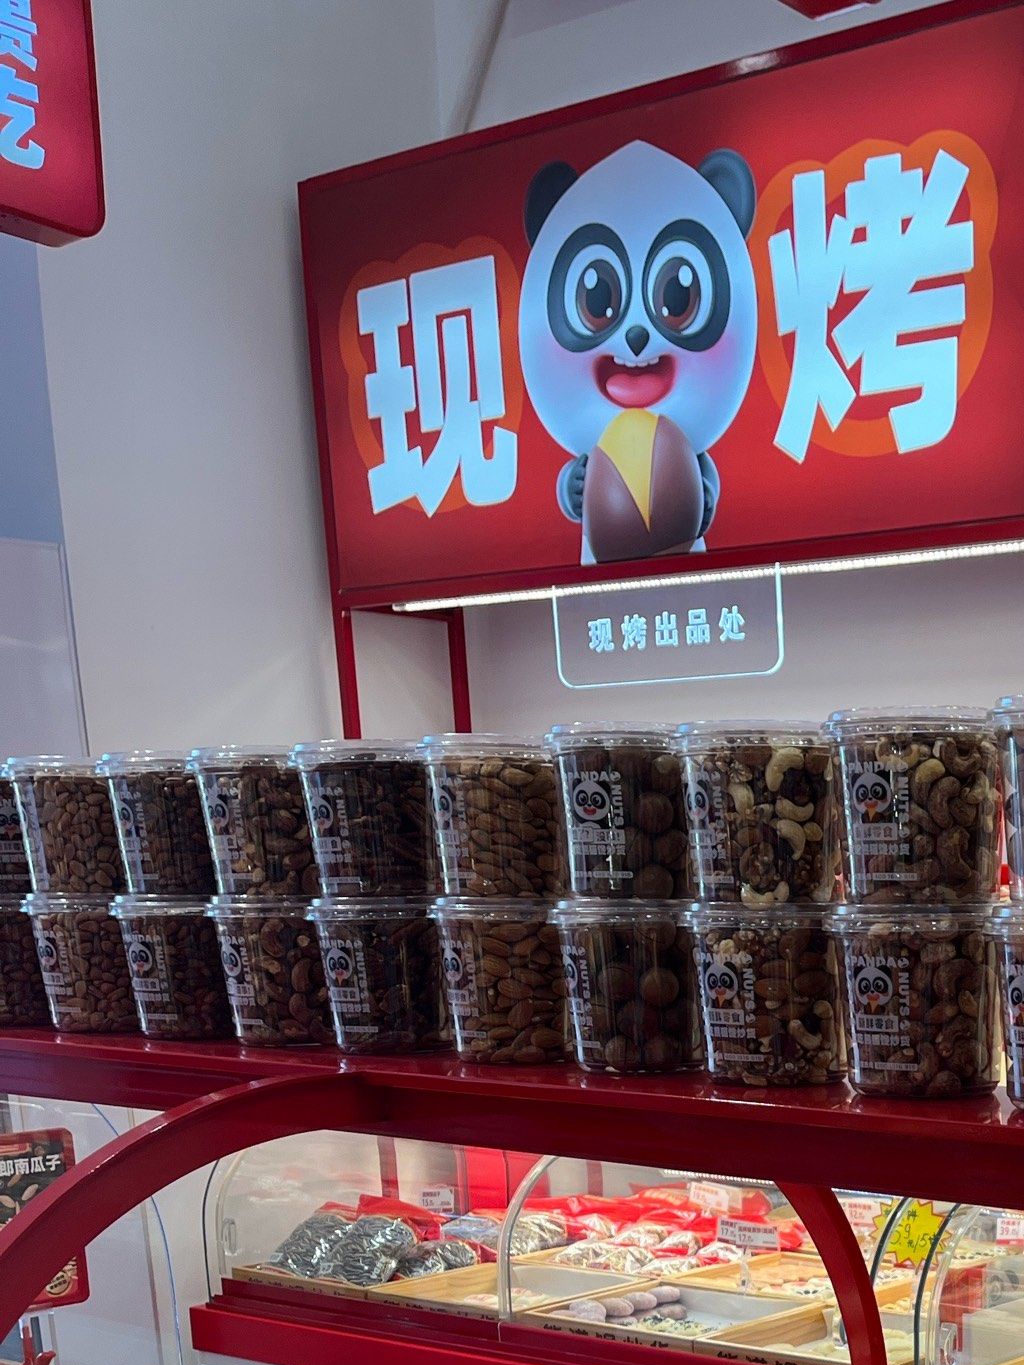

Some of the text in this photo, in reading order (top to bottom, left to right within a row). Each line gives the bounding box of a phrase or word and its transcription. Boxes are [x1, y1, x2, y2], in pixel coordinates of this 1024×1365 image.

[358, 149, 974, 517] 现 烤
[588, 606, 747, 653] 现烤出品处
